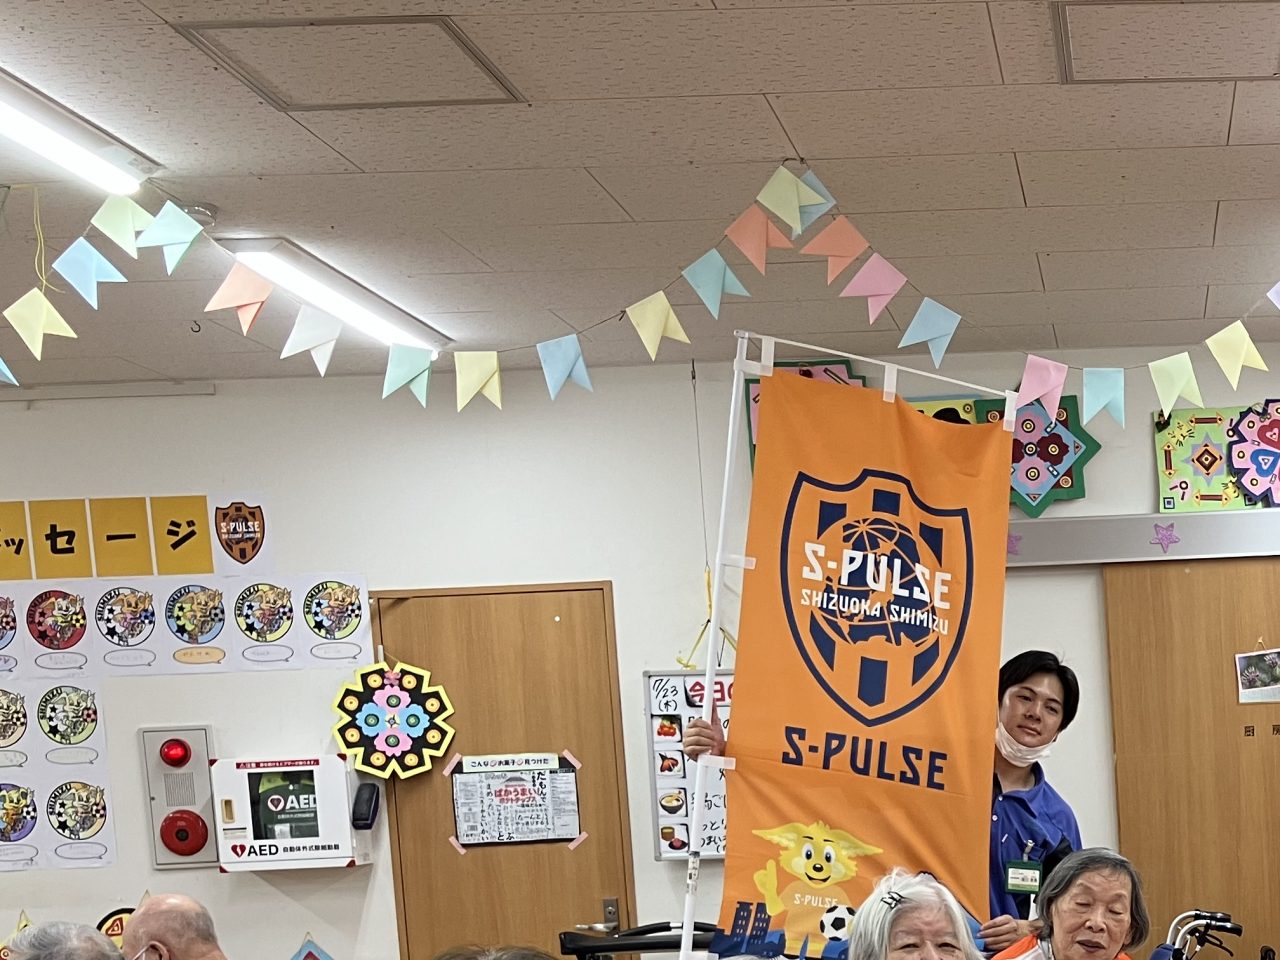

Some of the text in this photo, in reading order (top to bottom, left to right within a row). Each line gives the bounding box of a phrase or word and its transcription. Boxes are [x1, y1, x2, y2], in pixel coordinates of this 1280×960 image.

[0, 520, 197, 555] ッセージ
[221, 521, 260, 533] S-PULSE
[802, 542, 951, 610] S-PULSE
[801, 588, 949, 635] SHIZUOKA SHIMIZU
[653, 678, 678, 699] 7/23
[782, 726, 947, 790] S-PULSE
[285, 794, 317, 810] AED
[247, 844, 279, 857] AED
